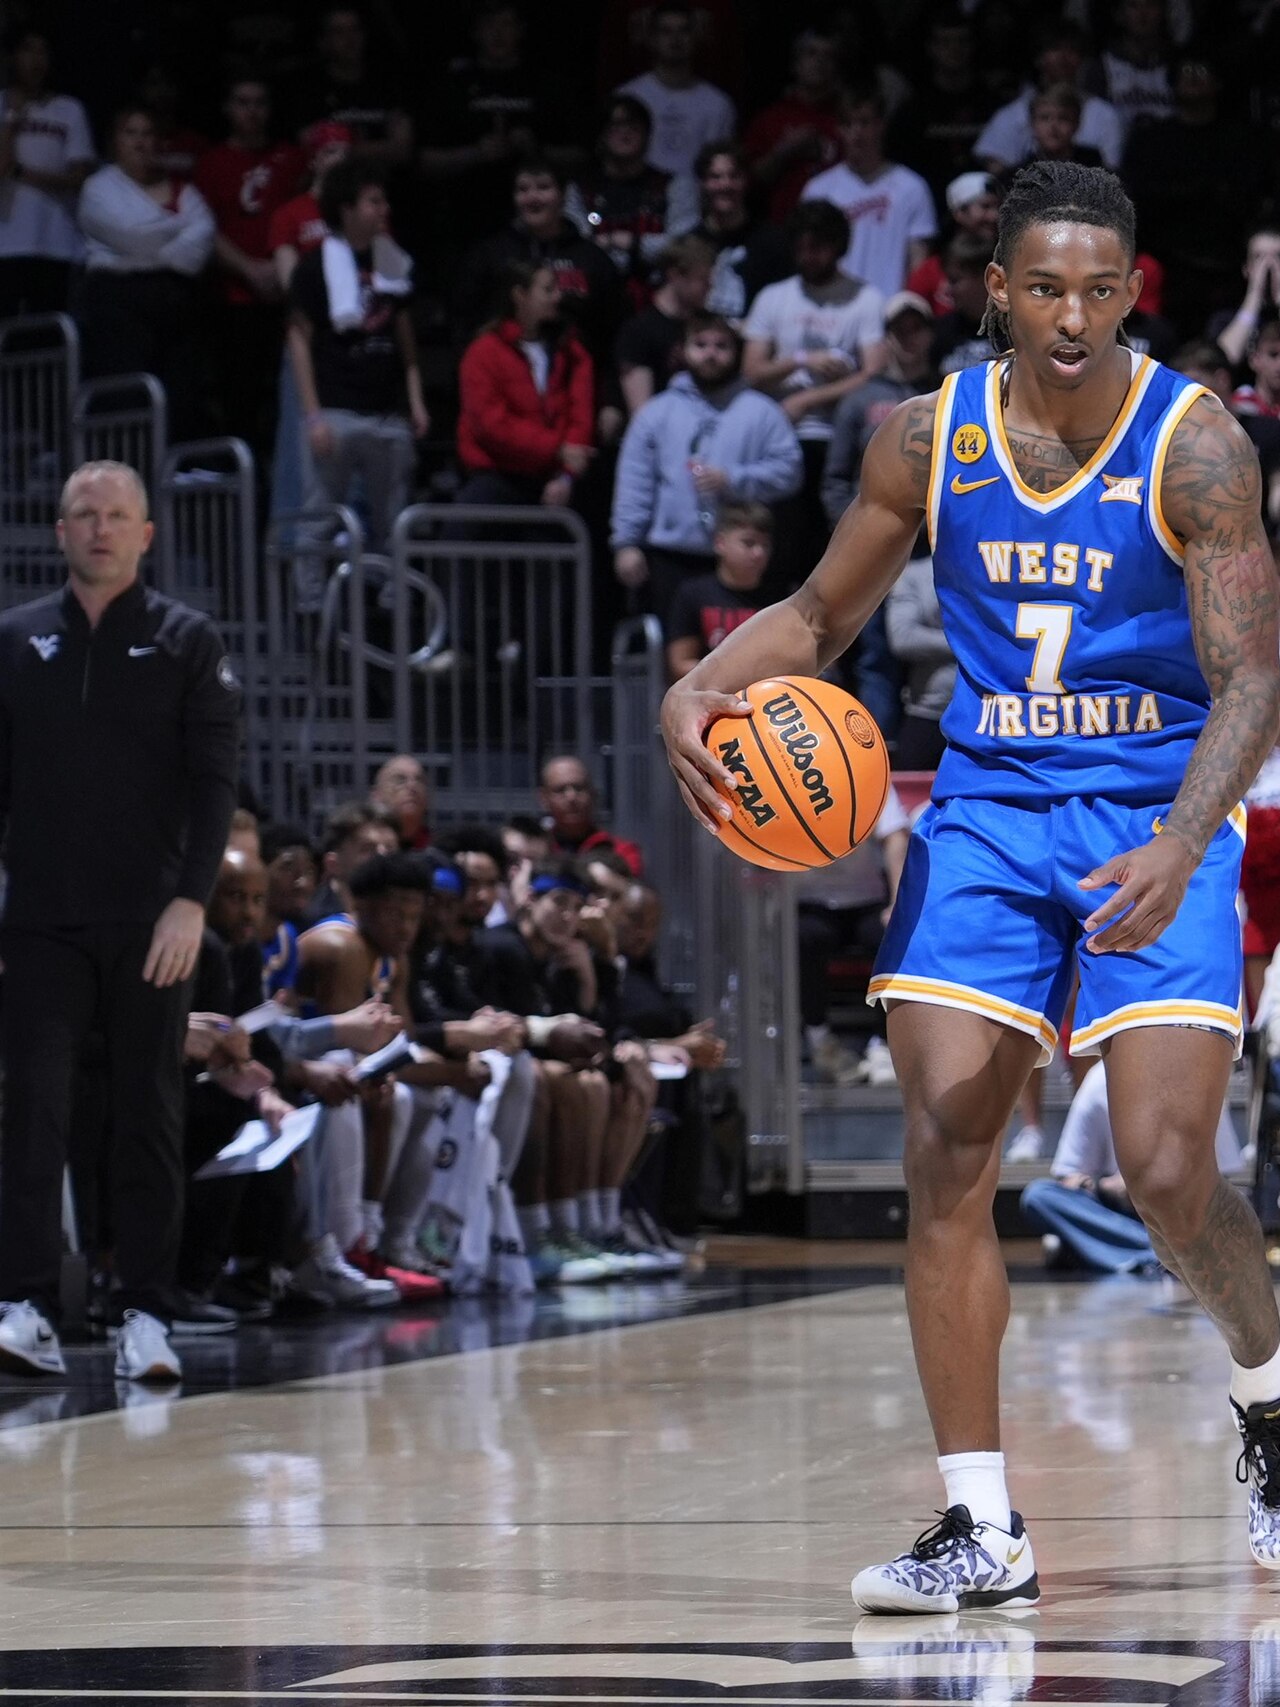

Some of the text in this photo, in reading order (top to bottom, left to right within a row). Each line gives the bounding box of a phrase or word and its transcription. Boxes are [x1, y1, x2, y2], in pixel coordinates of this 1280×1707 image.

[956, 438, 979, 454] 44
[978, 541, 1114, 592] WEST
[1015, 602, 1073, 694] 7
[717, 736, 778, 829] NCAA
[761, 692, 835, 816] Wilson
